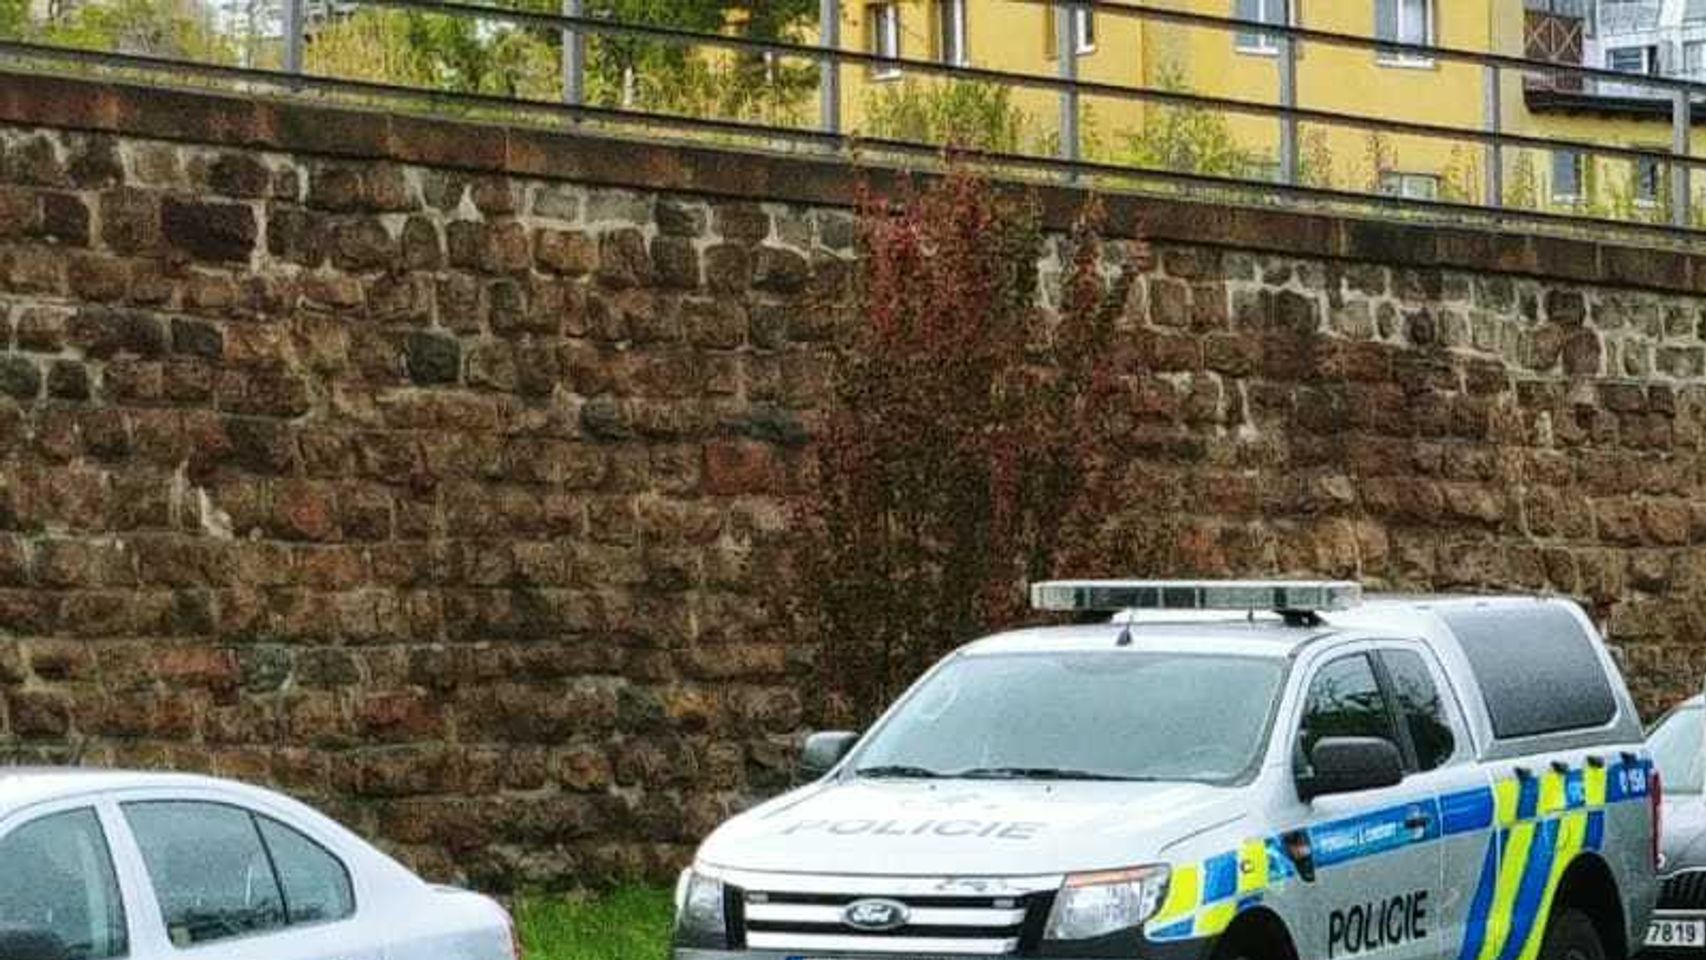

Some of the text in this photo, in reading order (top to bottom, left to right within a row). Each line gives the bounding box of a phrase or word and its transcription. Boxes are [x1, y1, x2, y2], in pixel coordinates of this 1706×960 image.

[781, 819, 1049, 840] POLICIE
[1329, 890, 1428, 959] POLICIE
[1647, 922, 1696, 942] 7819
